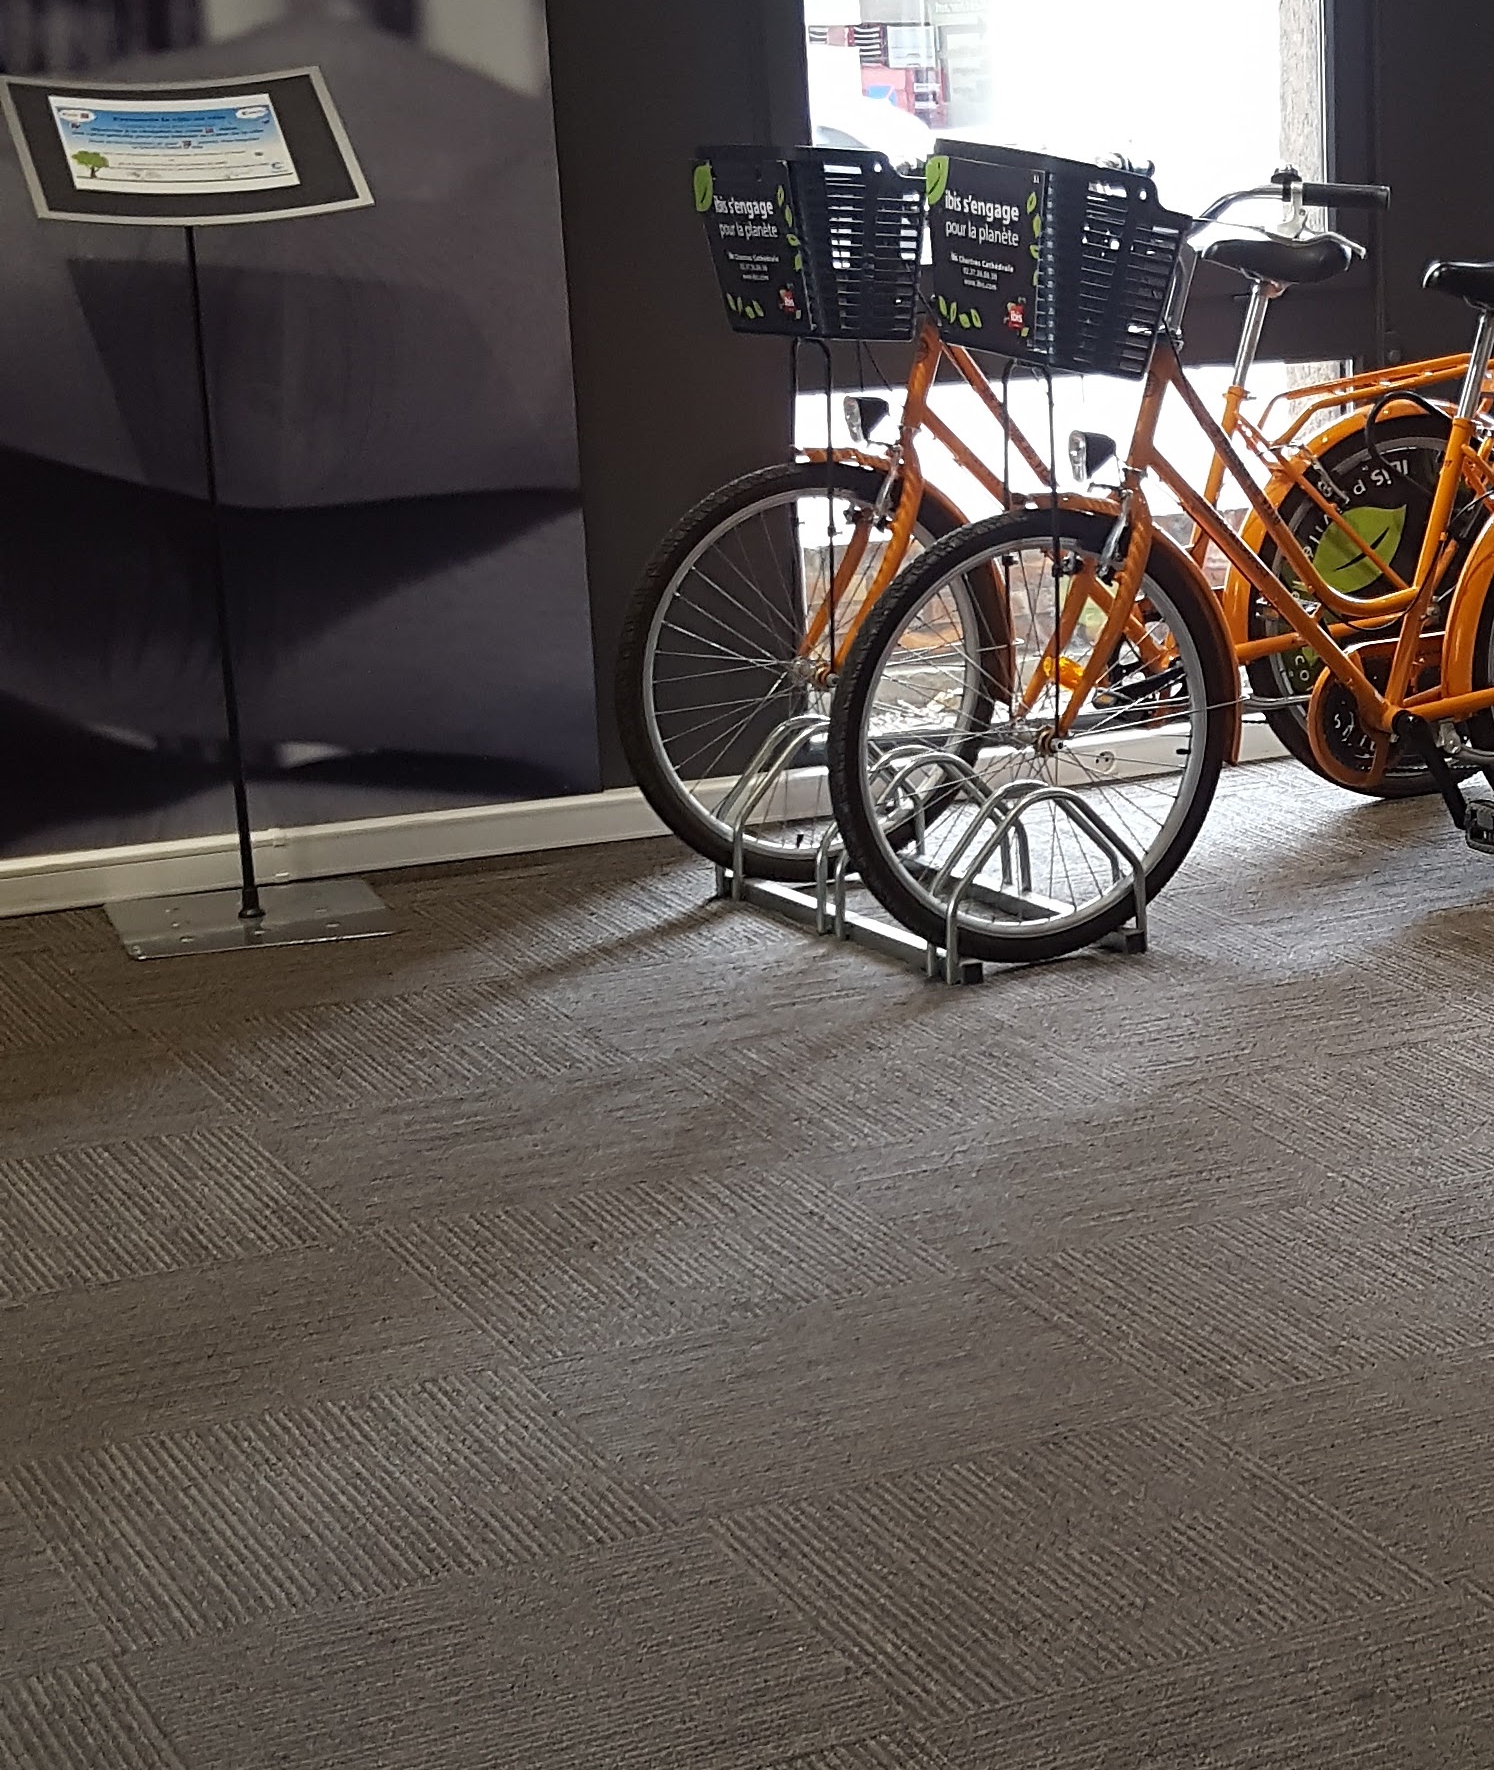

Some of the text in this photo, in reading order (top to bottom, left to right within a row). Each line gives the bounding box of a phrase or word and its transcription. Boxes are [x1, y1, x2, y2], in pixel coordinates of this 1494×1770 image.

[713, 194, 774, 220] ibis s'engage
[944, 188, 1020, 225] ibis s'engage
[719, 220, 779, 241] pour la planète
[945, 220, 1020, 247] pour la planète
[1010, 309, 1023, 324] ibis
